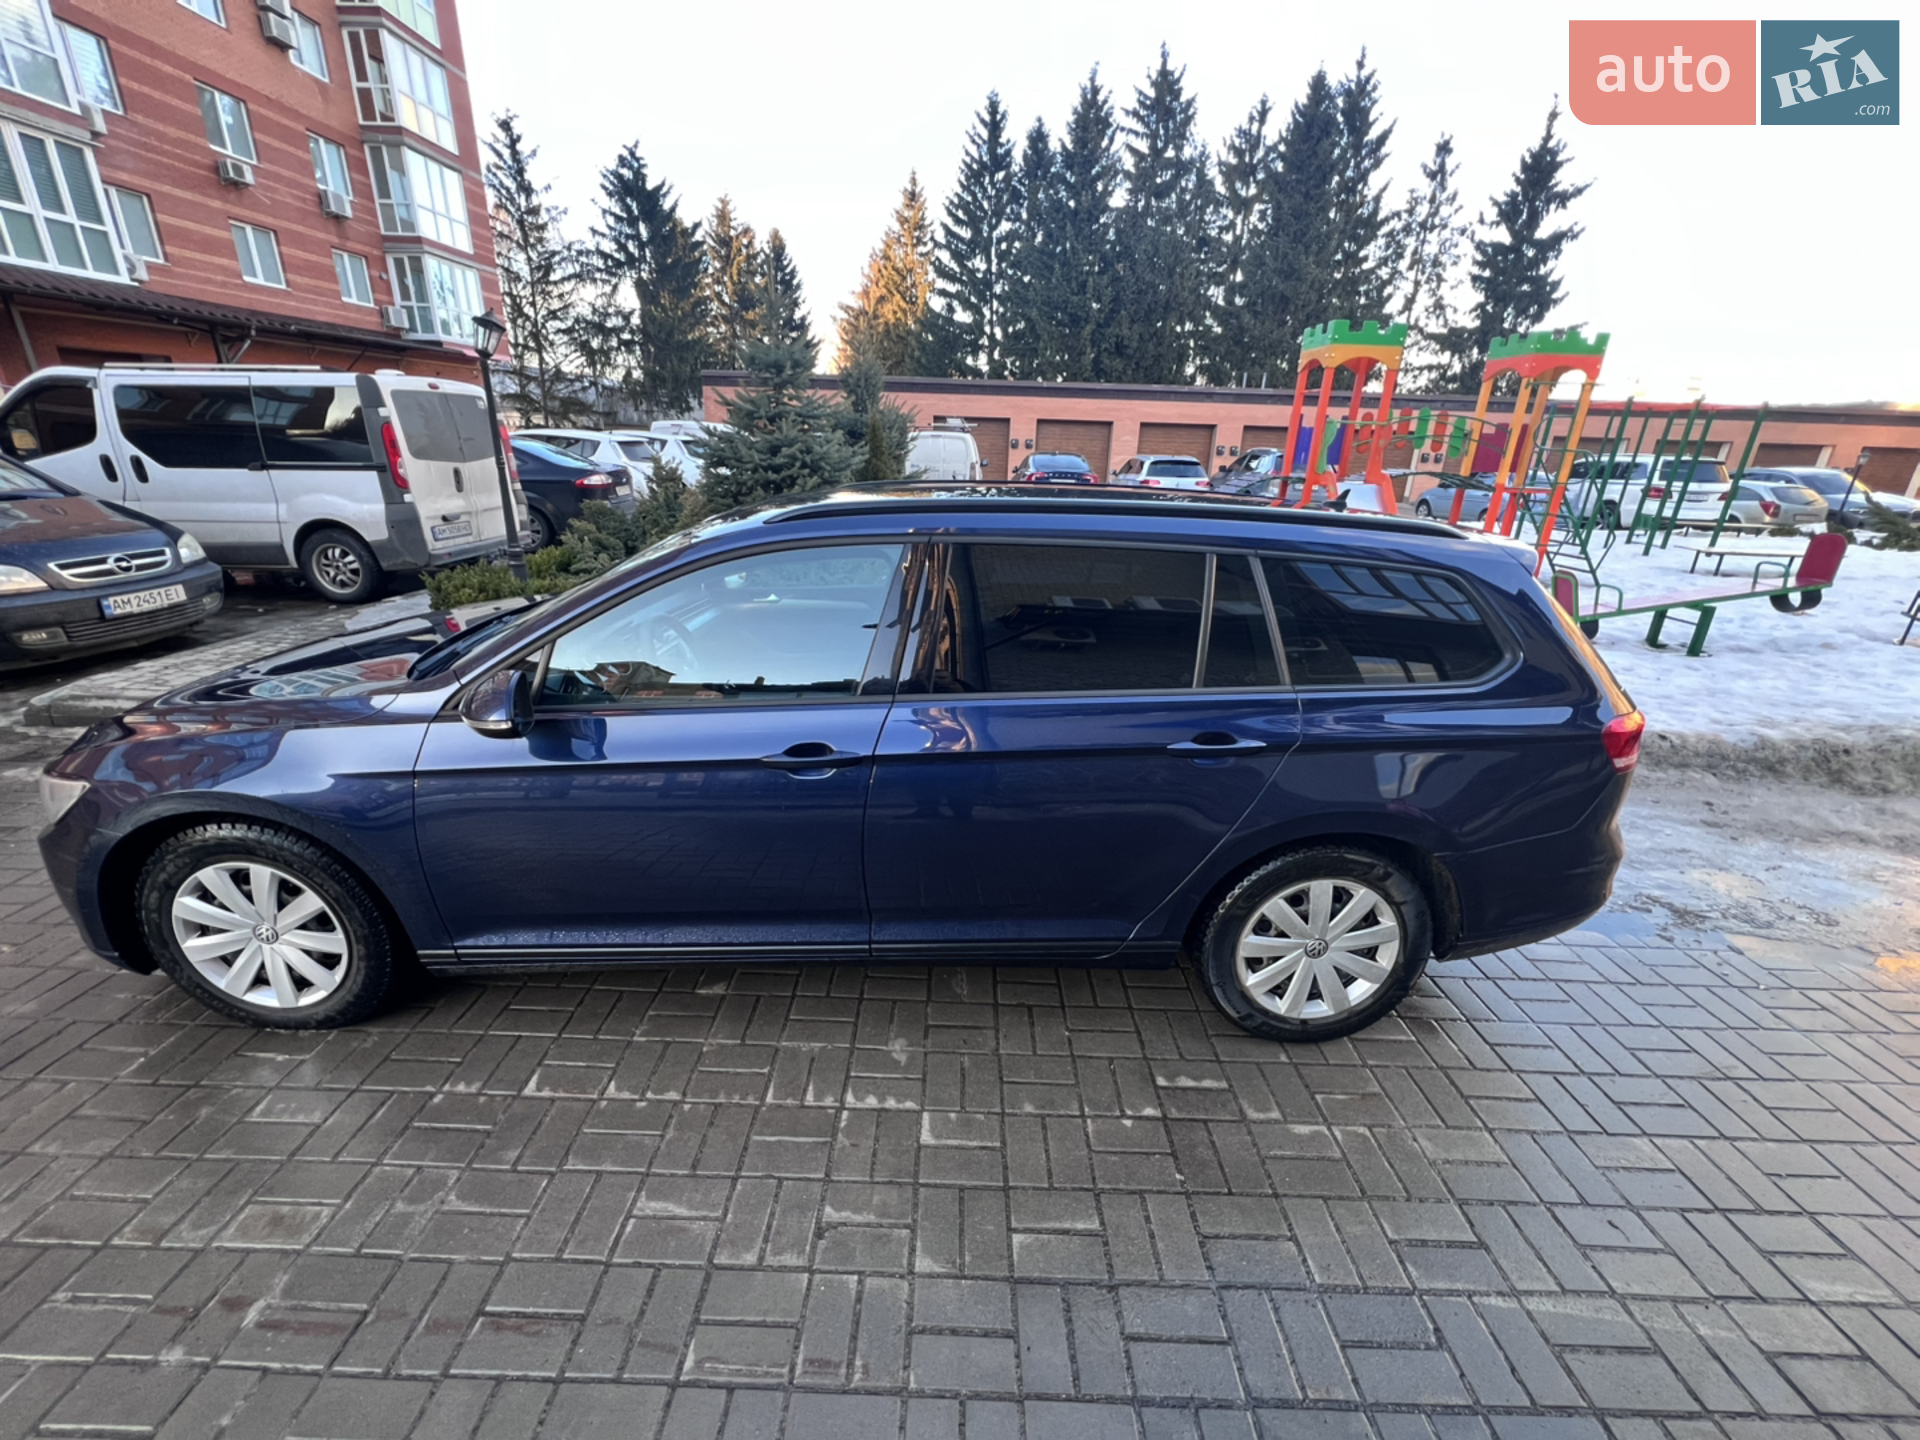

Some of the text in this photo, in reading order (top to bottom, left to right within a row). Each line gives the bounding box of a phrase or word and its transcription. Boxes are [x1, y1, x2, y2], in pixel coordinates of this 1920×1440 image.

[112, 597, 133, 612] AM
[133, 590, 164, 608] 2451
[164, 587, 180, 602] EI
